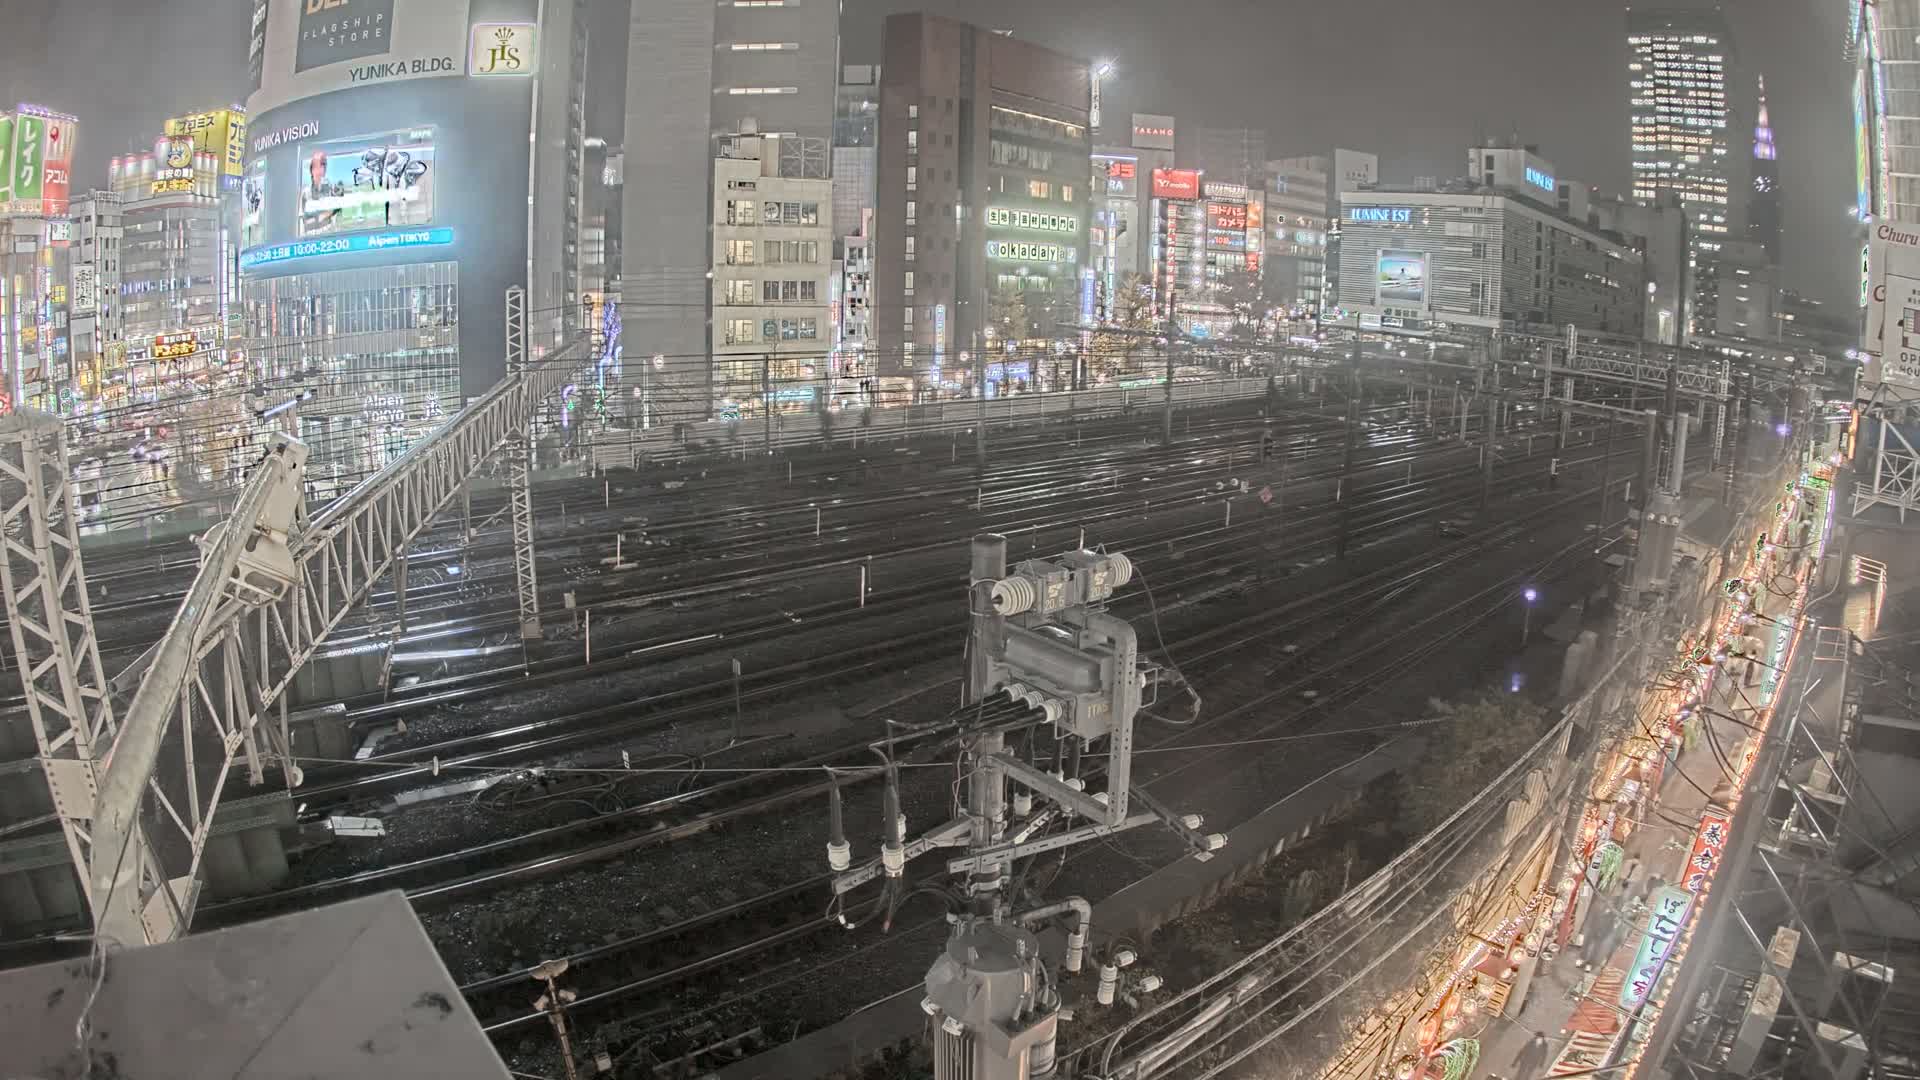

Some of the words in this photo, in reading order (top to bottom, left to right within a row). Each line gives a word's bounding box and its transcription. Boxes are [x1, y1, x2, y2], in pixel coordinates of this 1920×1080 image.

[303, 13, 384, 41] FLAGSHIP
[328, 27, 382, 47] STORE
[349, 61, 407, 83] YUNIKA
[410, 56, 456, 75] BLDG.
[254, 129, 281, 152] YUNIKA
[282, 121, 320, 142] VISION
[21, 120, 37, 187] レイク
[45, 168, 68, 184] アコム
[1208, 205, 1246, 216] ヨドバシ
[1351, 208, 1390, 222] LUMINE
[1391, 209, 1411, 222] EST
[1217, 218, 1246, 228] カメラ
[293, 238, 349, 256] 10:00-22:00
[367, 235, 399, 247] Alpen
[399, 232, 430, 242] TOKYO
[1000, 243, 1066, 260] okadaya
[1900, 352, 1920, 366] OP
